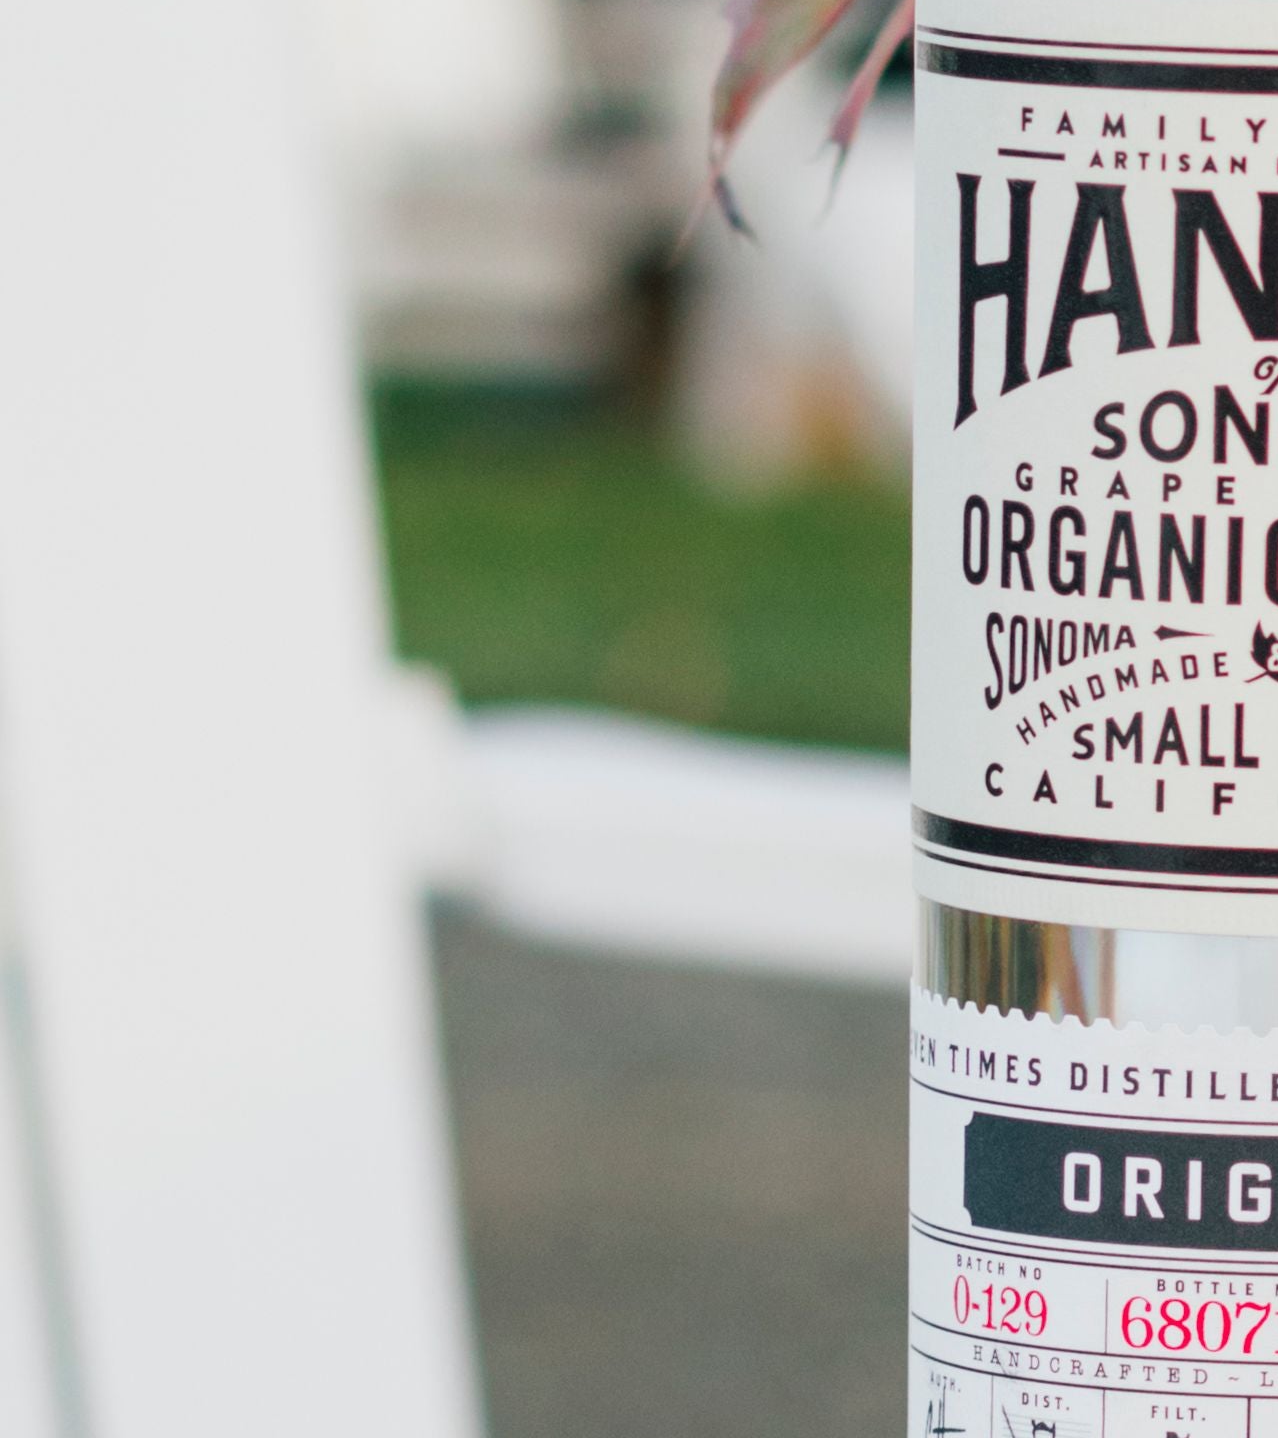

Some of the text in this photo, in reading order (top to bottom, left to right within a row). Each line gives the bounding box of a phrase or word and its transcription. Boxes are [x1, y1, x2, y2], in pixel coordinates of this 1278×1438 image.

[1021, 106, 1267, 144] FAMILY
[1089, 150, 1247, 175] ARTISAN
[1015, 461, 1236, 505] GRAPE
[984, 611, 1137, 710] SONOMA
[1015, 651, 1229, 746] HANDMADE
[1071, 702, 1260, 770] SMALL
[948, 1043, 1042, 1087] TIMES
[956, 1253, 1043, 1281] BATCH NO
[1156, 1278, 1255, 1296] BOTTLE
[952, 1275, 1048, 1337] 0-129
[972, 1345, 1209, 1385] HANDCRAFTED
[1021, 1392, 1071, 1412] DIST.
[1151, 1405, 1206, 1422] FILT.
